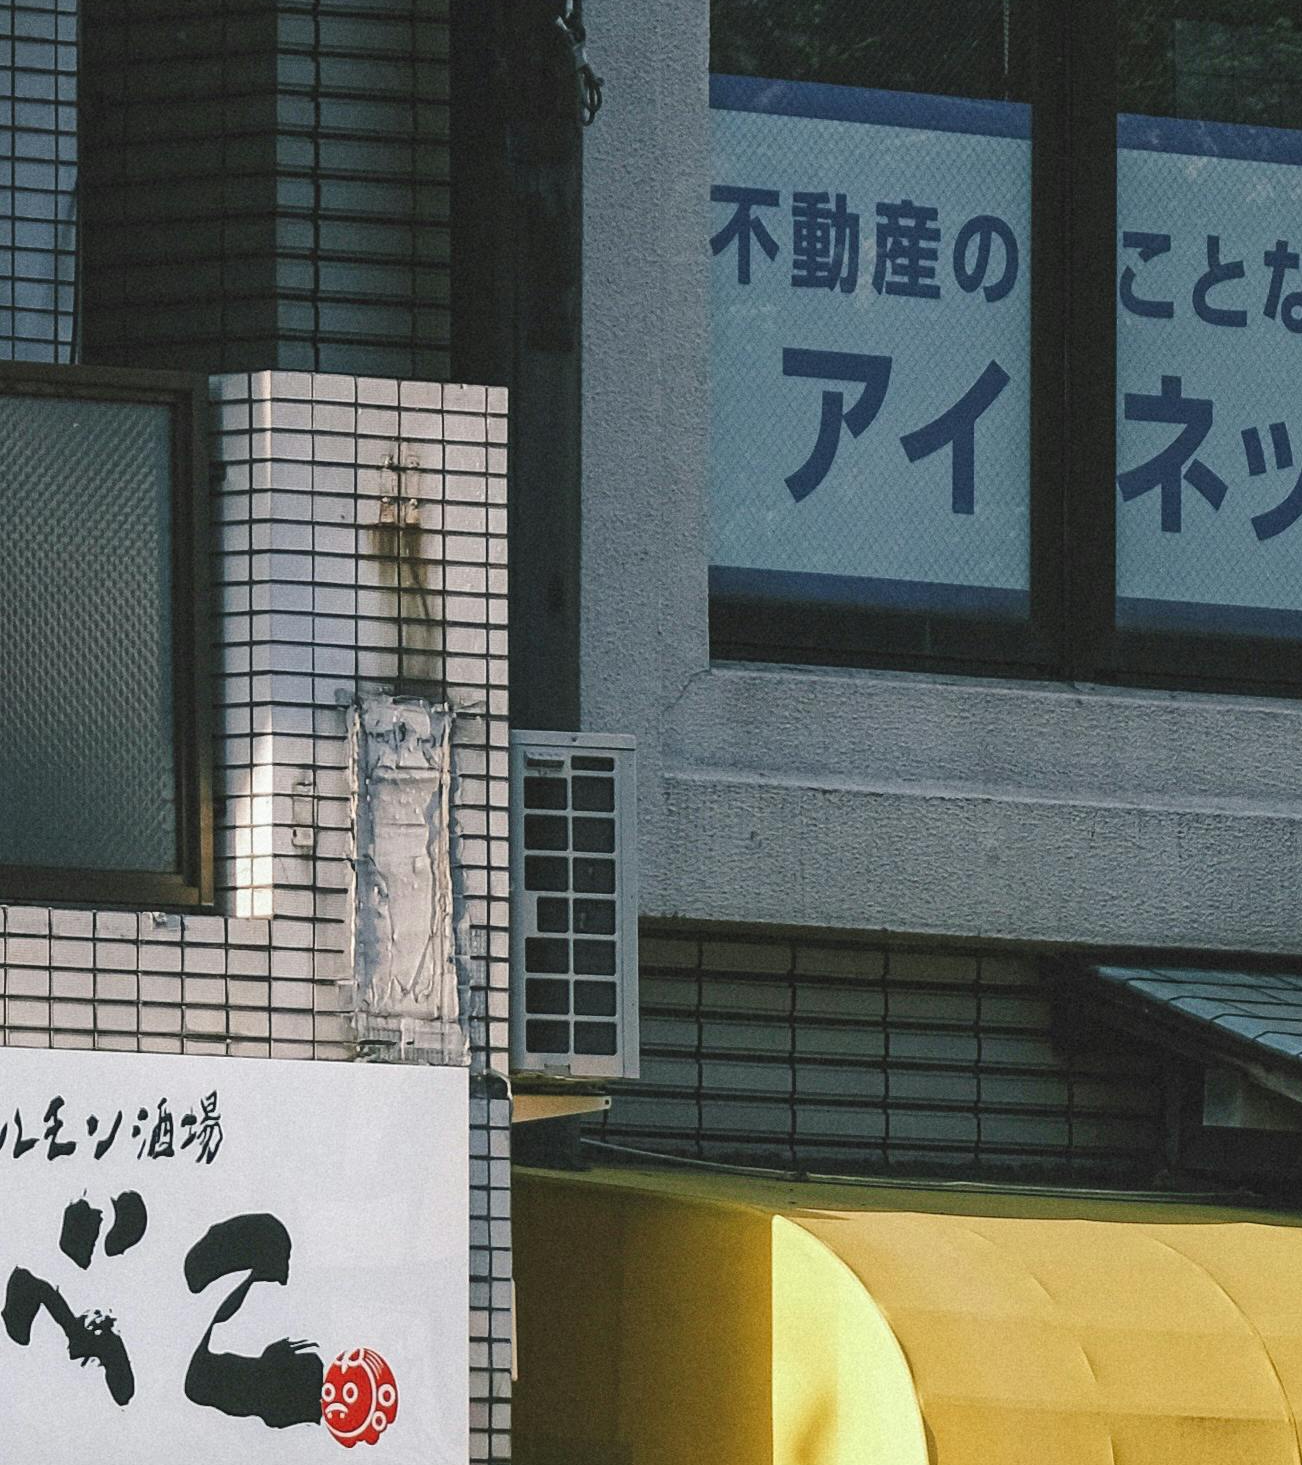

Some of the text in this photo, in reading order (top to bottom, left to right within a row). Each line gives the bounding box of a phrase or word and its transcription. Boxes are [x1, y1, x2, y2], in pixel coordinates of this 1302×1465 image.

[709, 184, 1020, 303] 不動産の
[782, 346, 1011, 516] アイ
